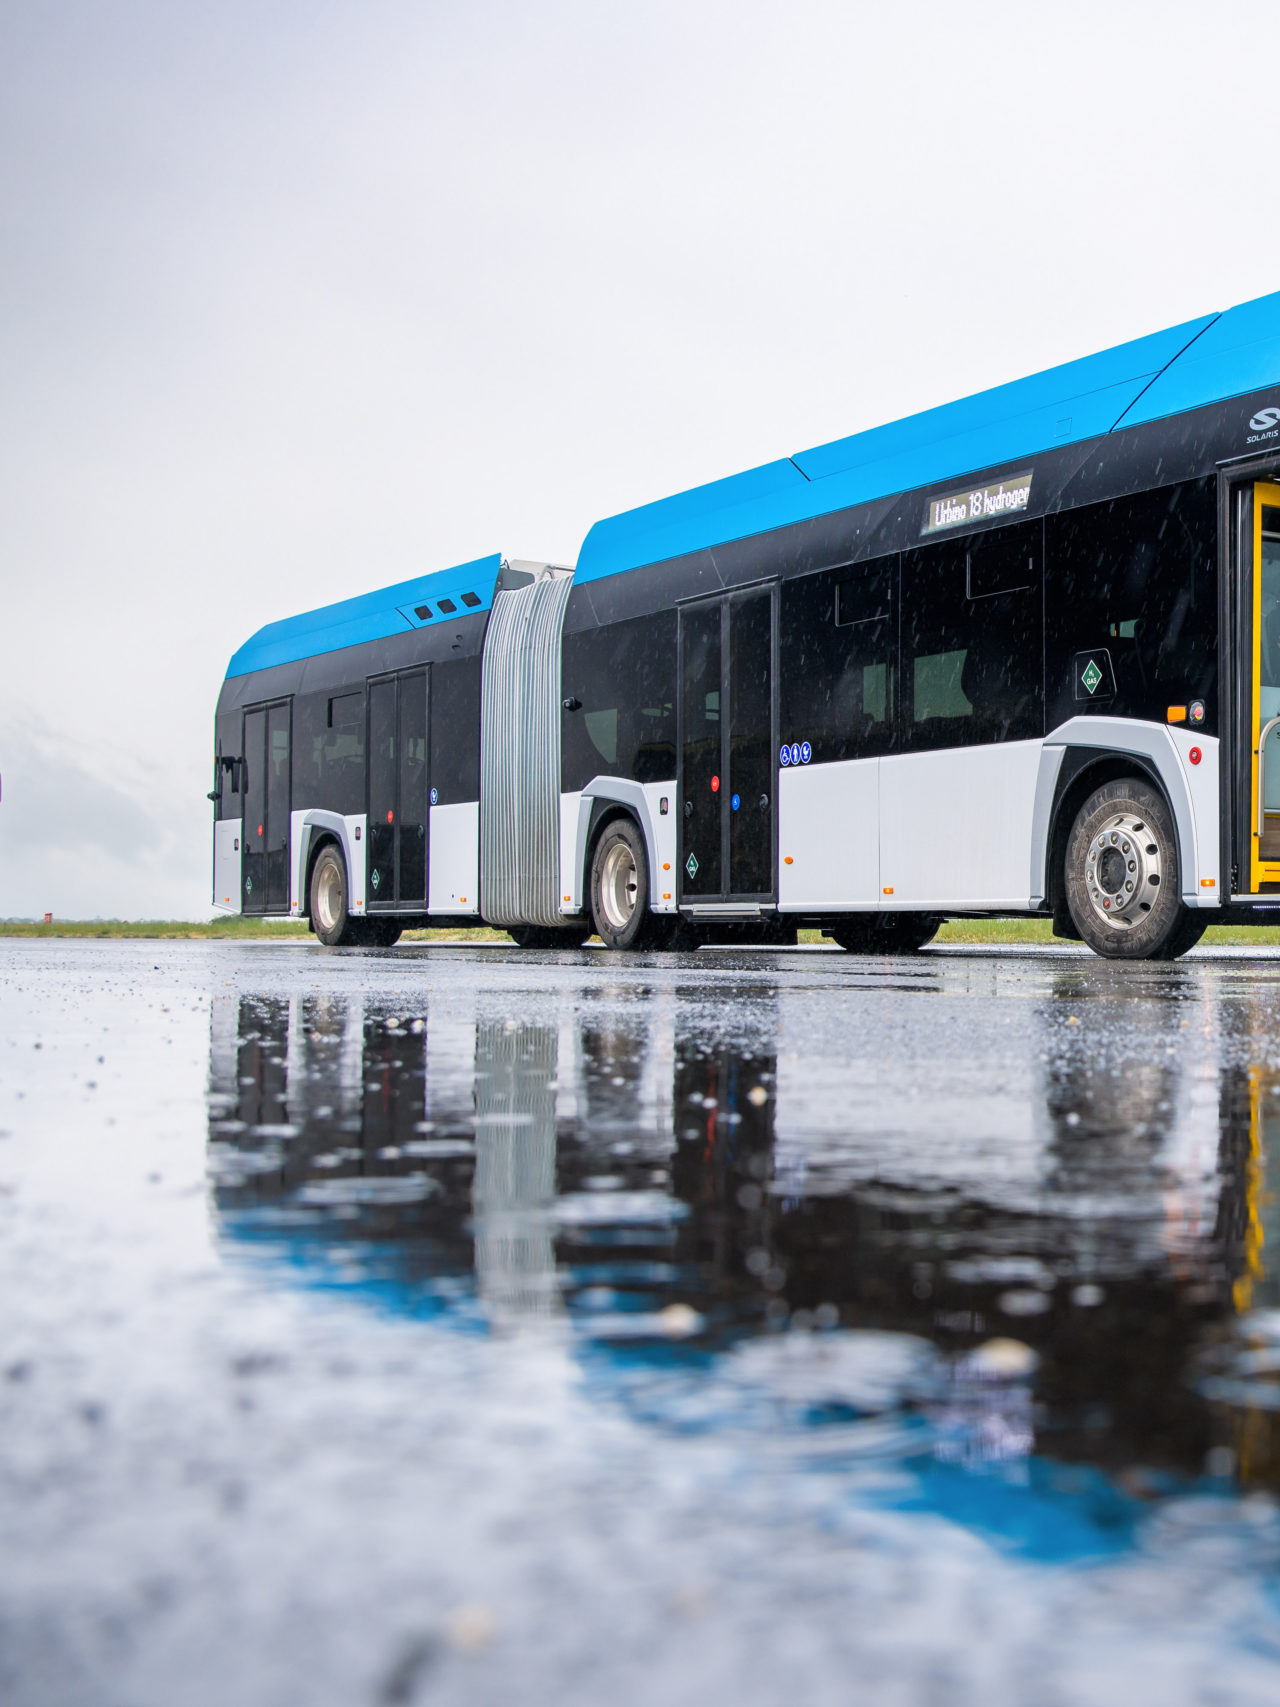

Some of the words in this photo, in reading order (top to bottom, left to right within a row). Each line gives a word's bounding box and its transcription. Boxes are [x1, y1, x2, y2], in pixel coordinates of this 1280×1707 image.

[1246, 430, 1279, 443] SOLARIS
[935, 499, 966, 526] Urbino
[969, 492, 983, 517] 18
